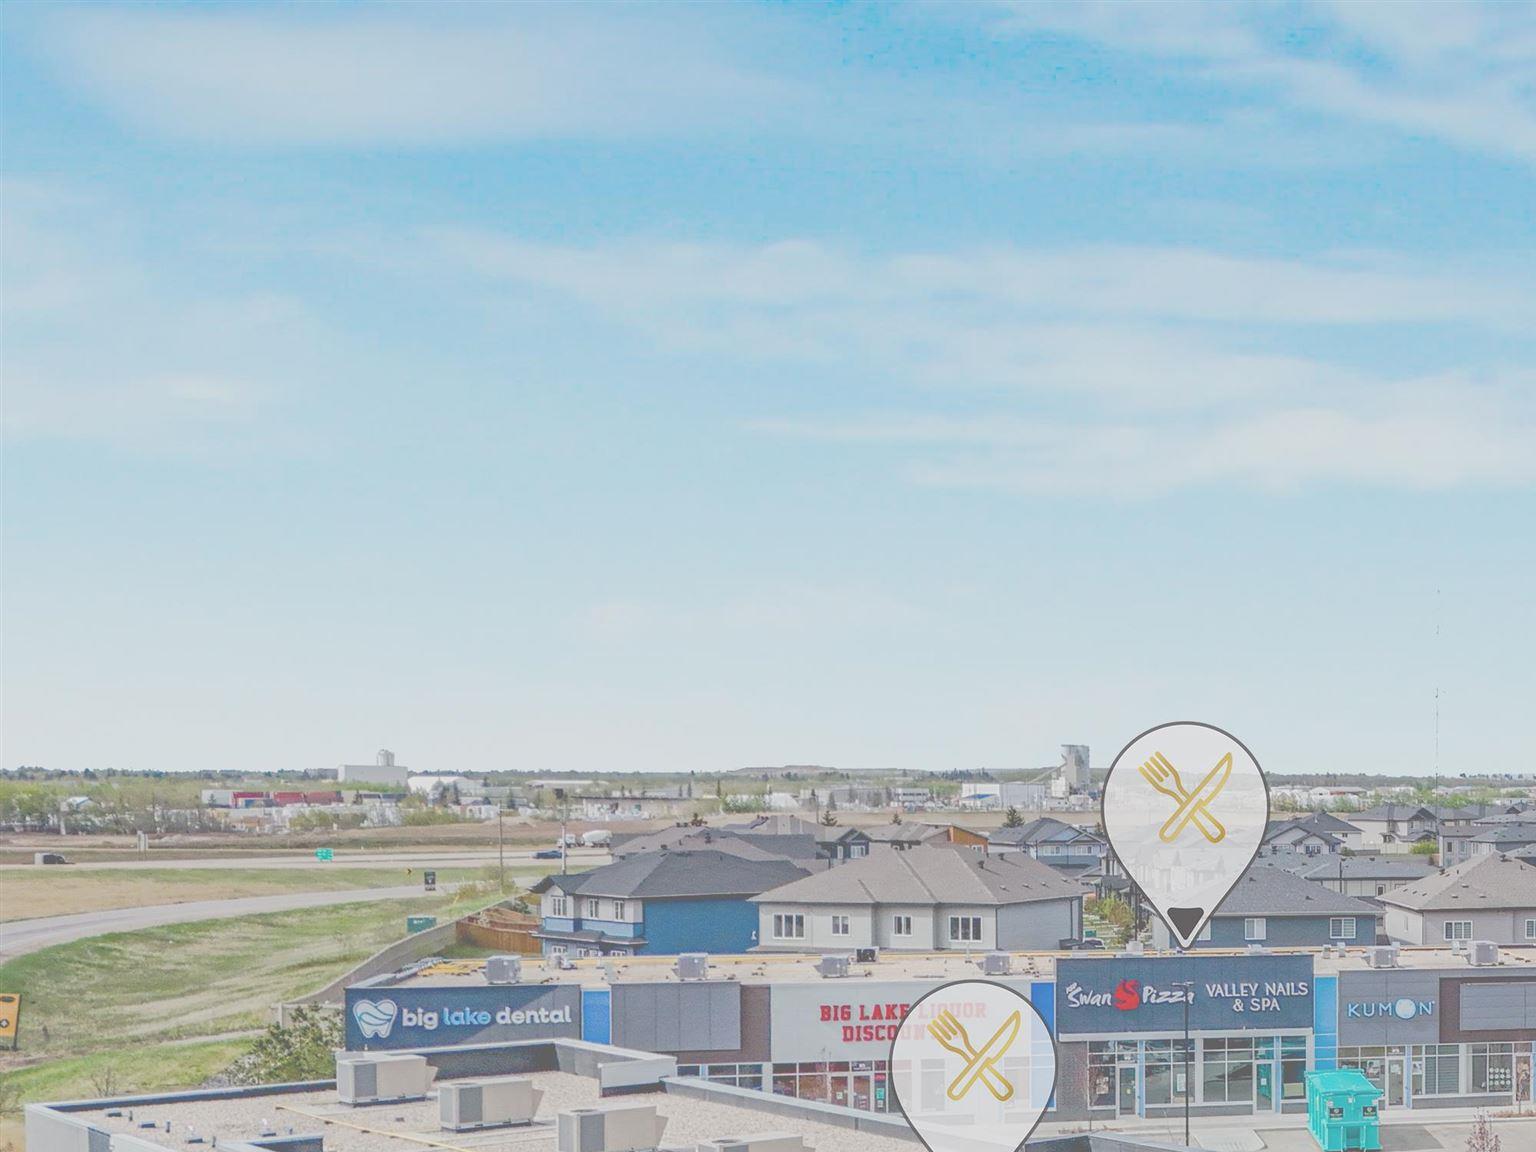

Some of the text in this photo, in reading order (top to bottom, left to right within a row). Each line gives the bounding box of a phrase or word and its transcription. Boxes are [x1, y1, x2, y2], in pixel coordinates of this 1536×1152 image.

[1067, 985, 1112, 1008] Swan
[1142, 985, 1195, 1004] Pizza
[1205, 981, 1309, 998] VALLEY NAILS
[819, 1004, 852, 1022] BIG
[858, 1002, 911, 1021] LAKE
[1232, 998, 1280, 1012] & SPA
[1347, 997, 1434, 1020] KUMON
[401, 1004, 572, 1031] big lake dental
